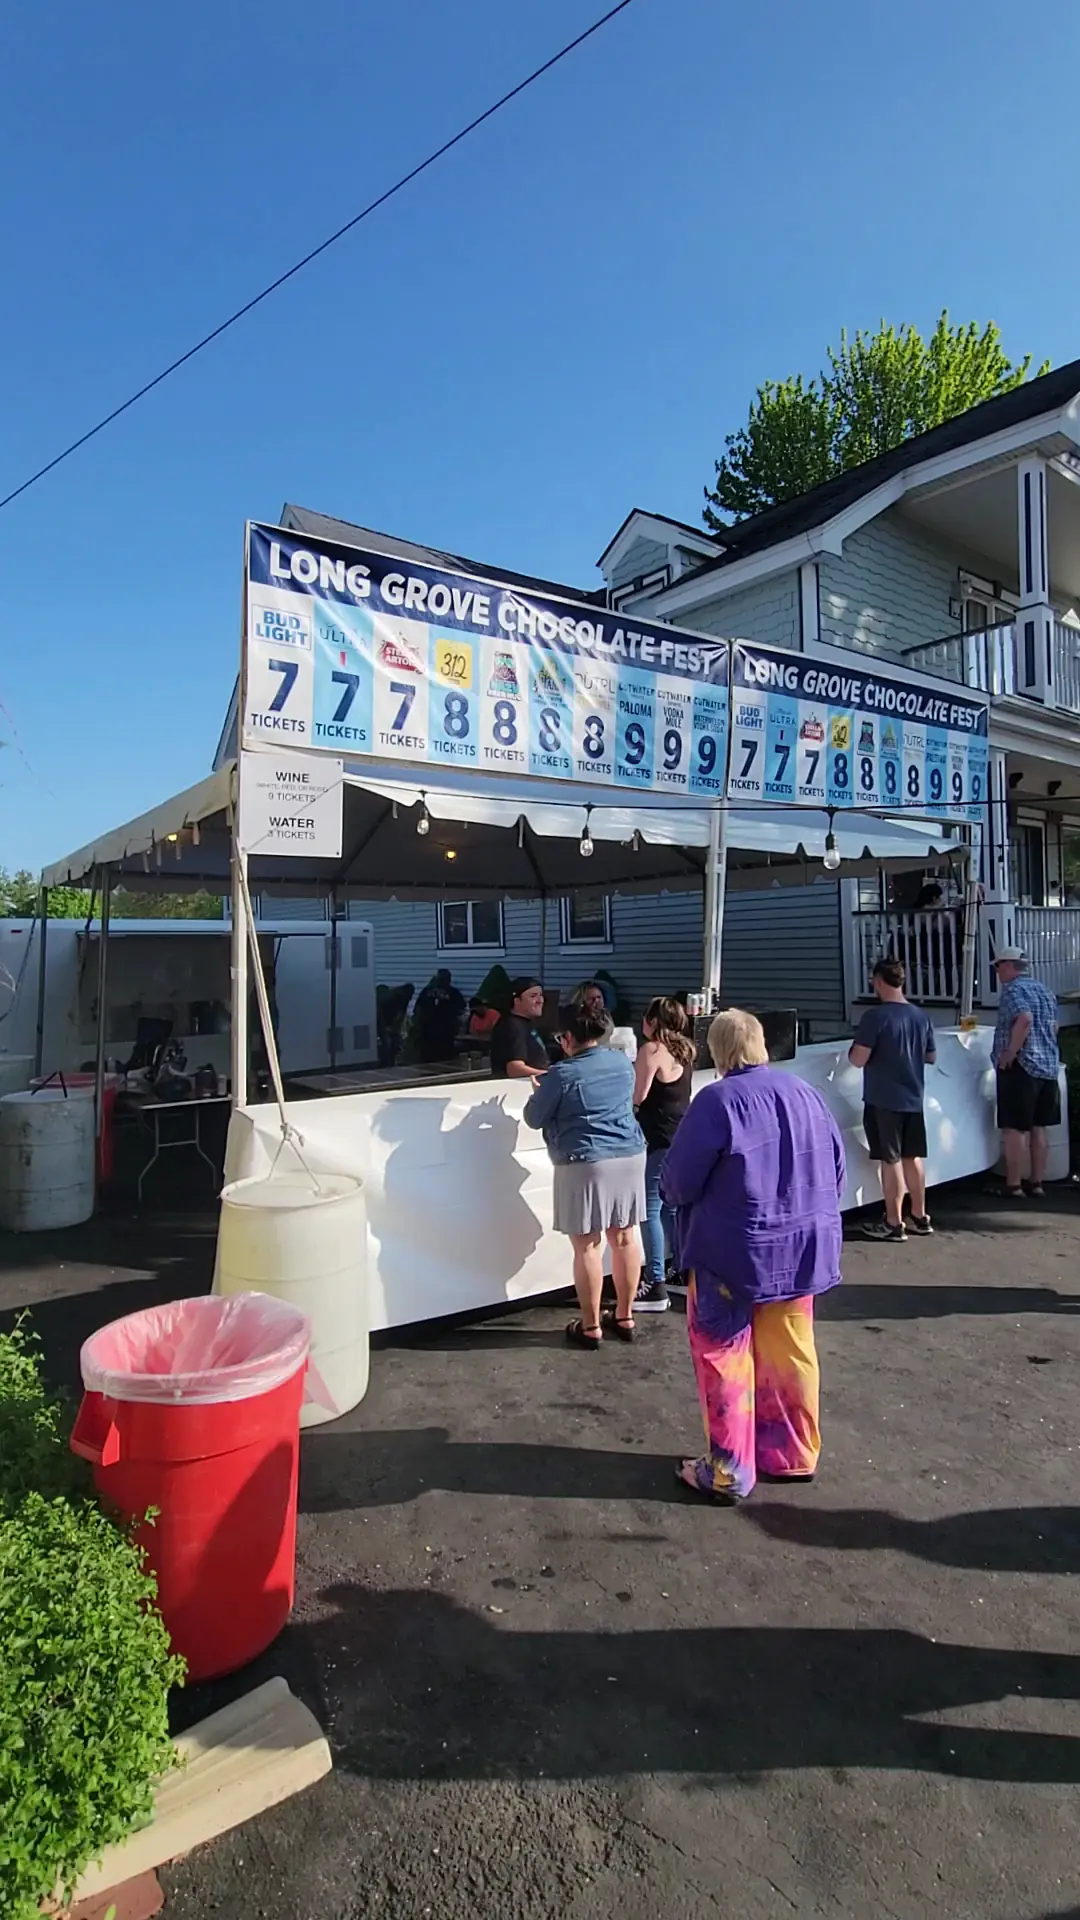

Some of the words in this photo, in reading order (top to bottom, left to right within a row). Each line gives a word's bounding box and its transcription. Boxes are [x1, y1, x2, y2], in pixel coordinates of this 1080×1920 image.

[269, 542, 371, 598] LONG
[379, 573, 491, 627] GROVE
[497, 599, 655, 662] CHOCOLATE
[660, 641, 713, 675] FEST
[263, 611, 301, 629] BUD
[255, 623, 308, 646] LIGHT
[441, 652, 467, 680] 312
[268, 658, 299, 712] 7
[743, 655, 799, 690] LONG
[802, 670, 861, 704] GROVE
[864, 684, 948, 722] CHOCOLATE
[950, 704, 982, 730] FEST
[331, 671, 360, 722] 7
[389, 681, 416, 731] 7
[443, 691, 470, 740] 8
[620, 701, 652, 718] PALOMA
[663, 707, 684, 719] VODKA
[739, 706, 760, 717] BUD
[251, 713, 305, 733] TICKETS
[315, 722, 366, 741] TICKETS
[492, 700, 517, 746] 8
[538, 707, 562, 752] 8
[666, 717, 682, 729] MULE
[736, 715, 763, 729] LIGHT
[379, 732, 425, 750] TICKETS
[582, 715, 605, 759] 8
[624, 722, 646, 765] 9
[433, 740, 476, 757] TICKETS
[484, 747, 525, 762] TICKETS
[663, 730, 683, 770] 9
[698, 735, 717, 775] 9
[740, 739, 758, 777] 7
[532, 753, 569, 768] TICKETS
[577, 760, 611, 774] TICKETS
[774, 744, 790, 781] 7
[805, 749, 820, 785] 7
[834, 753, 849, 788] 8
[276, 771, 310, 783] WINE
[617, 766, 651, 779] TICKETS
[656, 771, 687, 784] TICKETS
[691, 775, 720, 789] TICKETS
[861, 757, 874, 791] 8
[885, 761, 897, 794] 8
[907, 765, 919, 797] 8
[730, 779, 760, 791] TICKETS
[765, 782, 792, 794] TICKETS
[799, 786, 825, 798] TICKETS
[930, 768, 942, 800] 9
[952, 772, 963, 802] 9
[972, 775, 981, 803] 9
[277, 792, 316, 803] TICKETS
[828, 790, 852, 801] TICKETS
[269, 816, 315, 828] WATER
[277, 830, 316, 840] TICKETS
